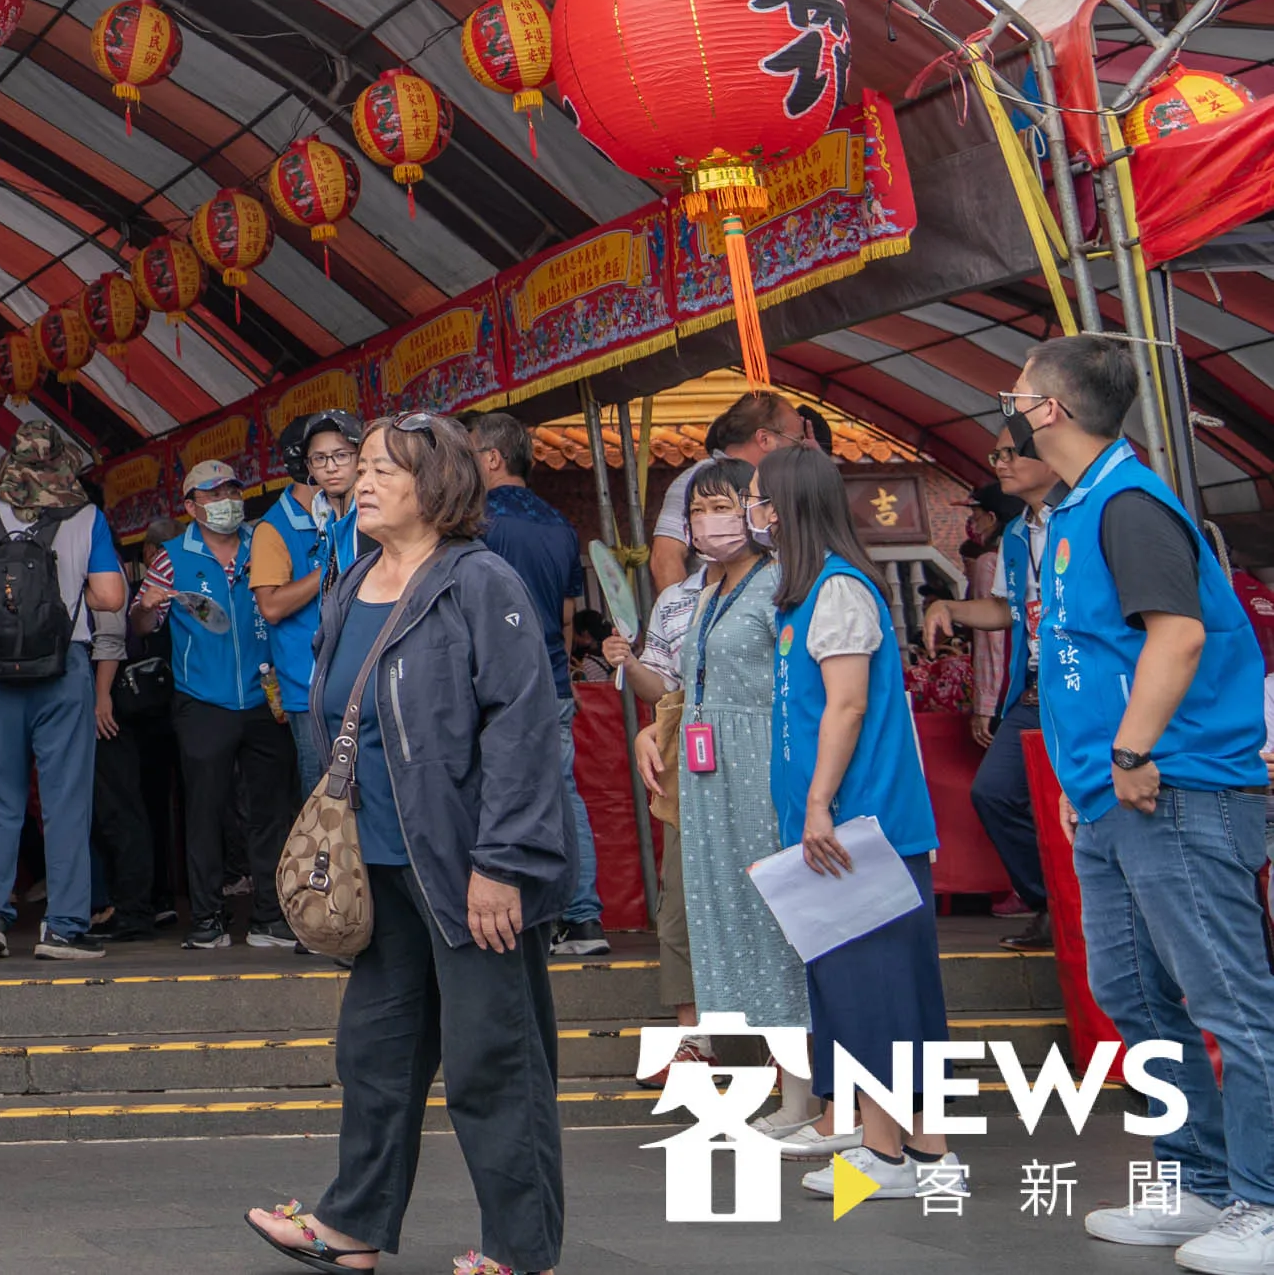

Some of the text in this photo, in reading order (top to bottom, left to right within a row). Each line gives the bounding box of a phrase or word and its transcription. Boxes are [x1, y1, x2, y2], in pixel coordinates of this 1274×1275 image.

[870, 486, 898, 526] 吉
[1053, 576, 1081, 691] 新竹縣政府
